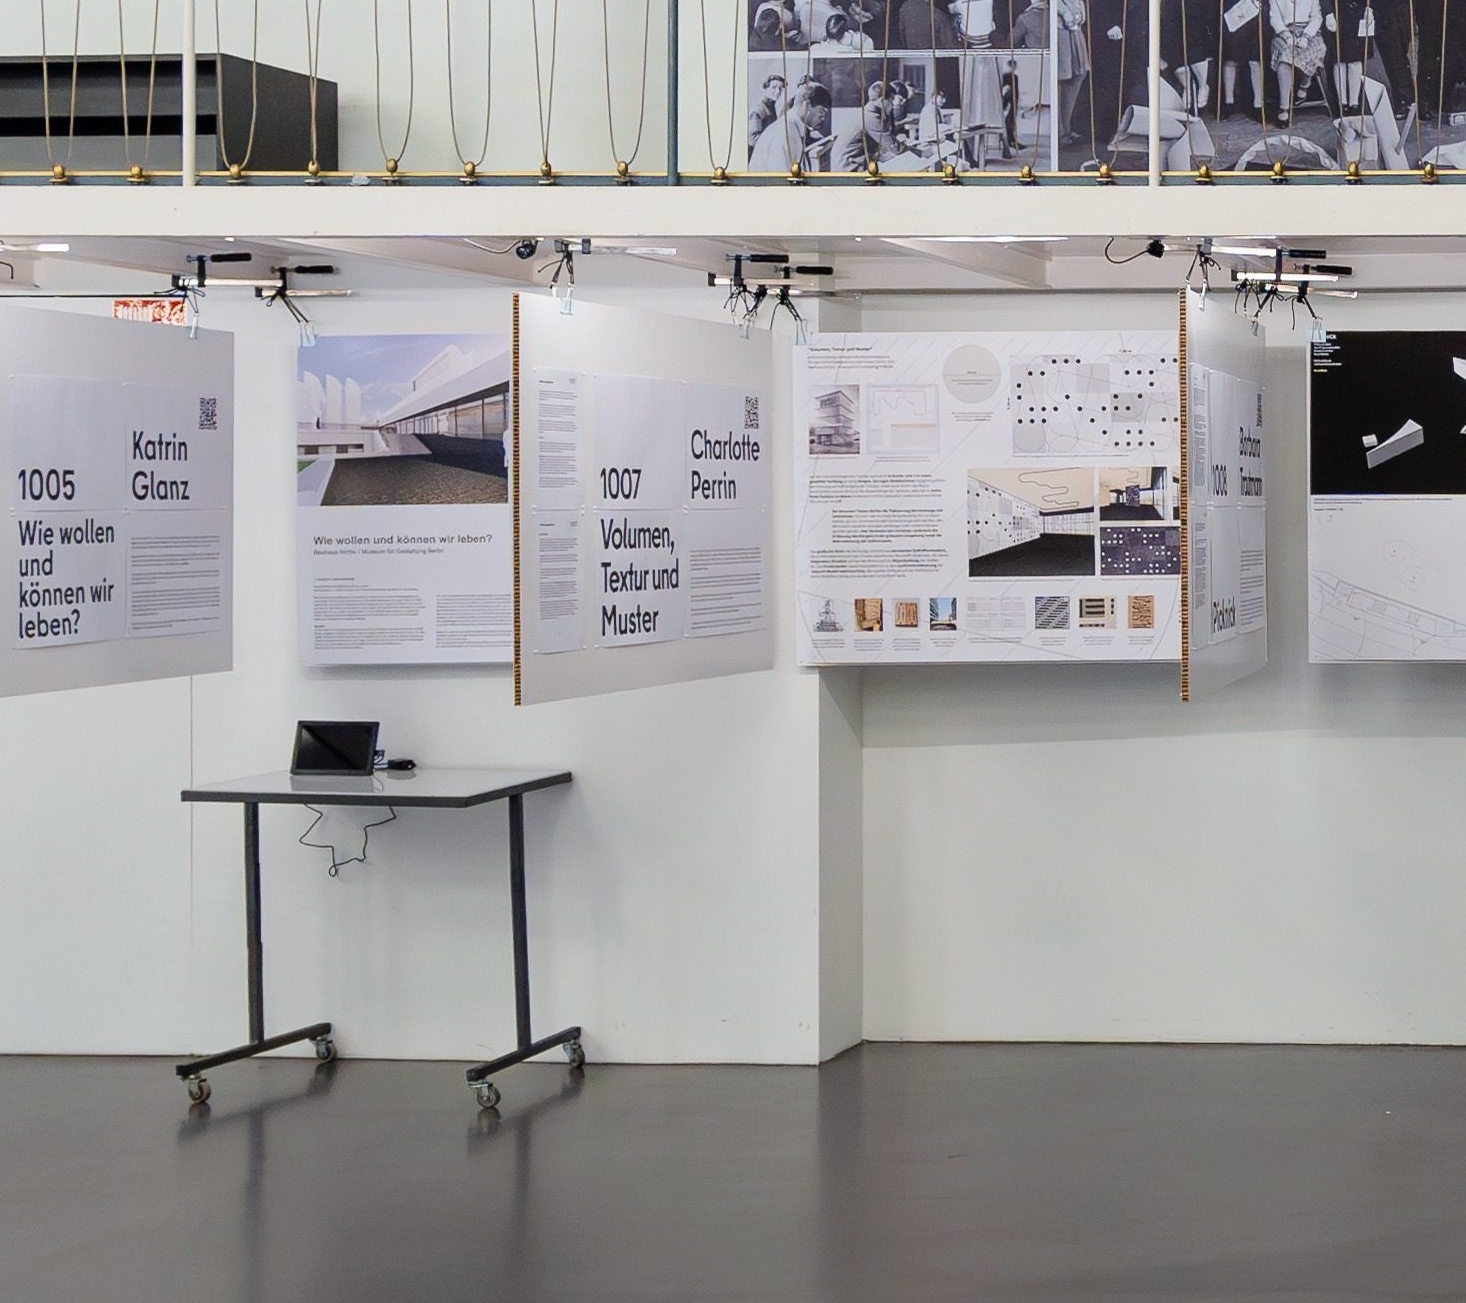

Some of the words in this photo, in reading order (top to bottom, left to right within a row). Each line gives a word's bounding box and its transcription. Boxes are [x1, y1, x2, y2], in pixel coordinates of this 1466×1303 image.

[132, 431, 188, 461] Katrin
[691, 430, 760, 462] Charlotte
[1239, 426, 1261, 459] Barbara
[18, 469, 75, 501] 1005
[132, 471, 190, 501] Glanz
[600, 468, 642, 500] 1007
[691, 470, 737, 500] Perrin
[1212, 464, 1228, 497] 1008
[18, 520, 55, 546] Wie
[59, 516, 115, 545] wollen
[313, 535, 333, 545] Wie
[336, 535, 370, 545] wollen
[373, 535, 394, 545] und
[397, 534, 435, 545] können
[439, 534, 454, 544] wir
[457, 534, 493, 544] leben?
[600, 518, 676, 555] Volumen,
[19, 550, 54, 577] und
[600, 561, 649, 594] Textur
[651, 558, 679, 591] und
[19, 582, 85, 608] können
[90, 578, 114, 603] wir
[19, 608, 80, 639] leben?
[602, 604, 660, 637] Muster
